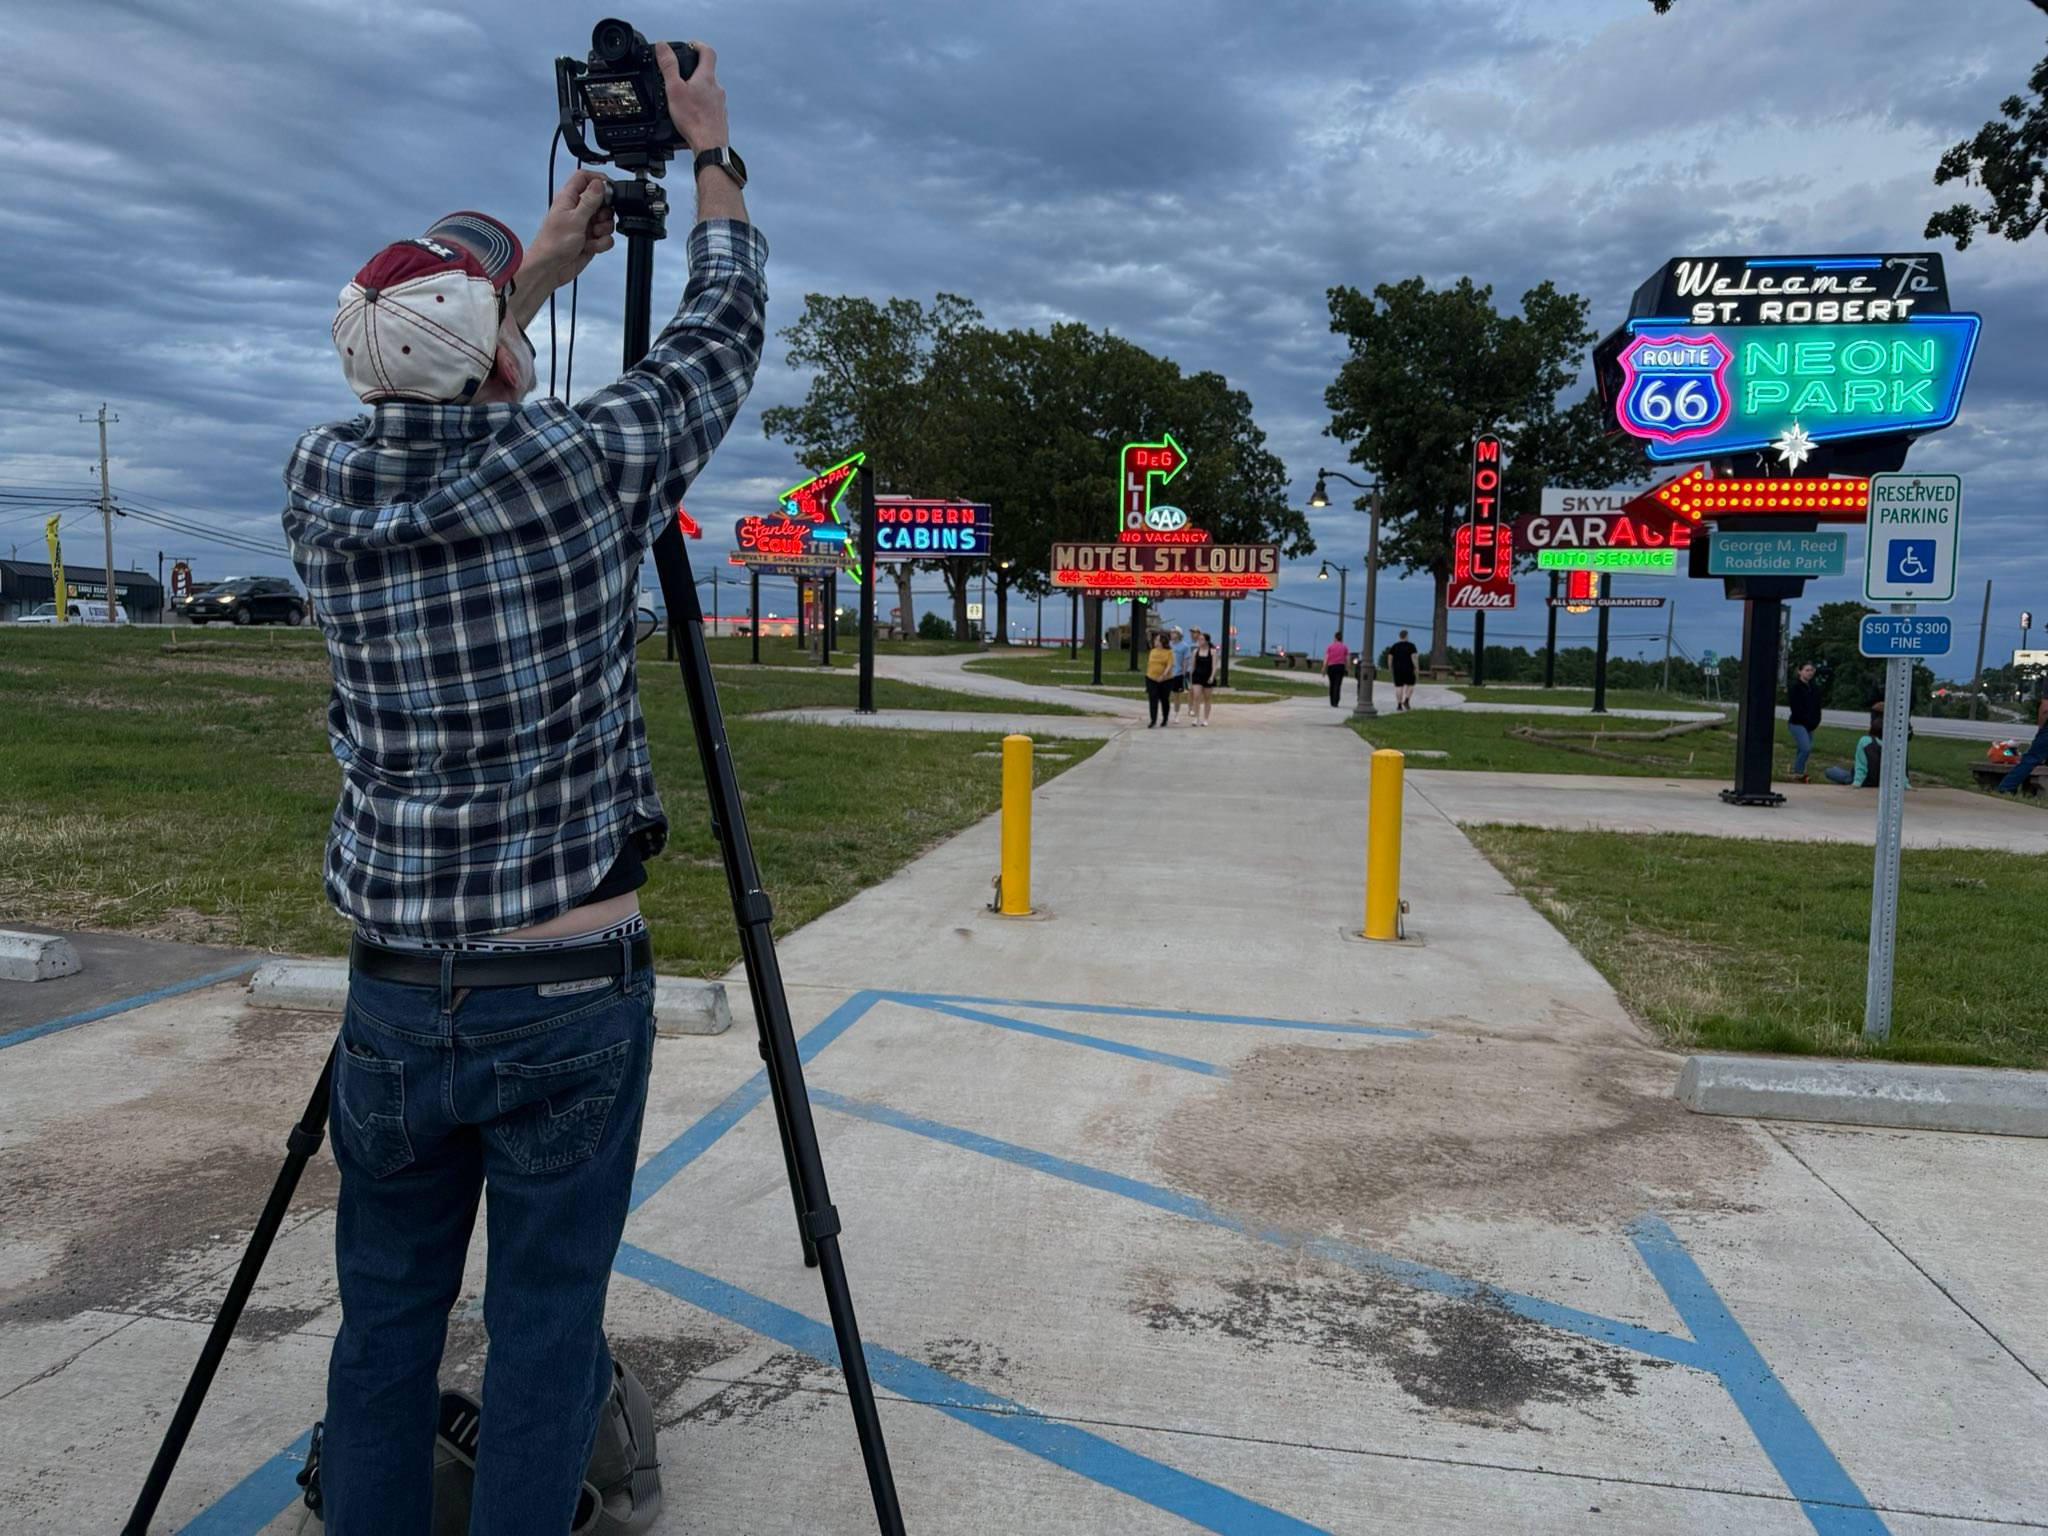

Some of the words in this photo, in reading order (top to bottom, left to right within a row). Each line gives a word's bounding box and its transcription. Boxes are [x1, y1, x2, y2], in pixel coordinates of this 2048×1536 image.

[1675, 261, 1878, 297] Welcome
[1886, 257, 1939, 300] To
[1691, 302, 1742, 325] ST.
[1759, 299, 1915, 323] ROBERT
[1643, 350, 1710, 367] ROUTE
[1744, 338, 1936, 377] NEON
[1640, 379, 1709, 423] 66
[1744, 378, 1939, 415] PARK
[1877, 486, 1955, 502] RESERVED
[878, 508, 975, 523] MODERN
[1474, 441, 1499, 574] MOTEL
[1150, 509, 1181, 529] AAA
[1880, 508, 1949, 524] PARKING
[740, 519, 810, 547] Stanley
[877, 527, 976, 550] CABINS
[1122, 532, 1141, 543] NO
[1145, 533, 1208, 543] VACANCY
[1719, 540, 1772, 554] George
[1777, 540, 1796, 551] M.
[1801, 540, 1838, 552] Reed
[1056, 547, 1144, 571] MOTEL
[1155, 548, 1190, 571] ST.
[1195, 548, 1274, 572] LOUIS
[1541, 551, 1587, 566] AUTO
[1594, 551, 1675, 566] SERVICE
[1725, 557, 1791, 568] Roadside
[1796, 557, 1827, 569] Park
[1058, 571, 1080, 584] 44
[1086, 589, 1100, 597] AIR
[1105, 589, 1161, 597] CONDITIONED
[1189, 590, 1216, 598] STEAM
[1220, 590, 1241, 598] HEAT
[1551, 599, 1567, 607] ALL
[1569, 599, 1596, 607] WORK
[1598, 599, 1660, 607] GUARANTEED
[1866, 622, 1890, 635] $50
[1895, 623, 1912, 635] TO
[1916, 622, 1948, 635] $300
[1891, 638, 1921, 649] FINE
